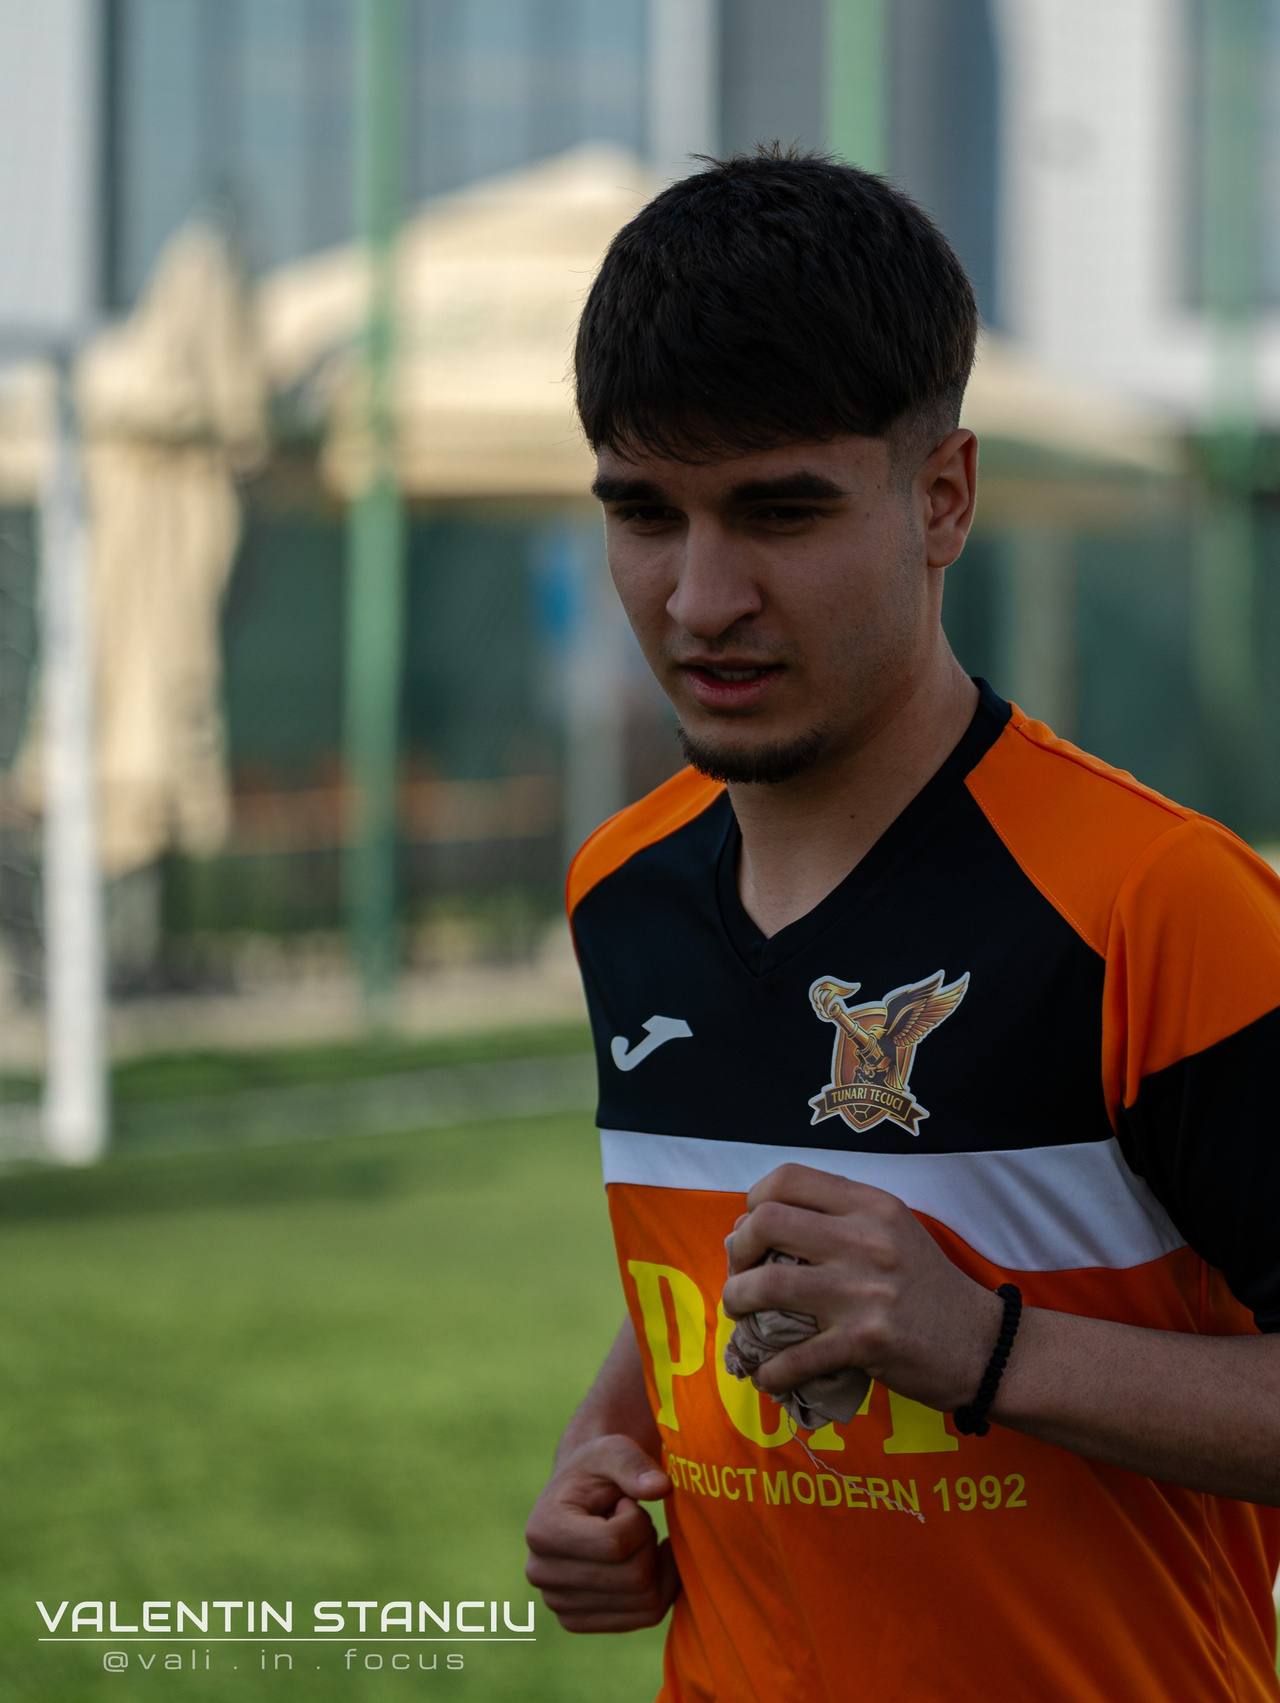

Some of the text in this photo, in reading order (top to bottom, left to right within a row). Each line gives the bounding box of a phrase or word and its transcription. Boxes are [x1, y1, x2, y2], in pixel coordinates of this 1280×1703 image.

[831, 1087, 904, 1111] TUNARI TECUCI
[763, 1470, 920, 1512] MODERN
[933, 1474, 1028, 1512] 1992
